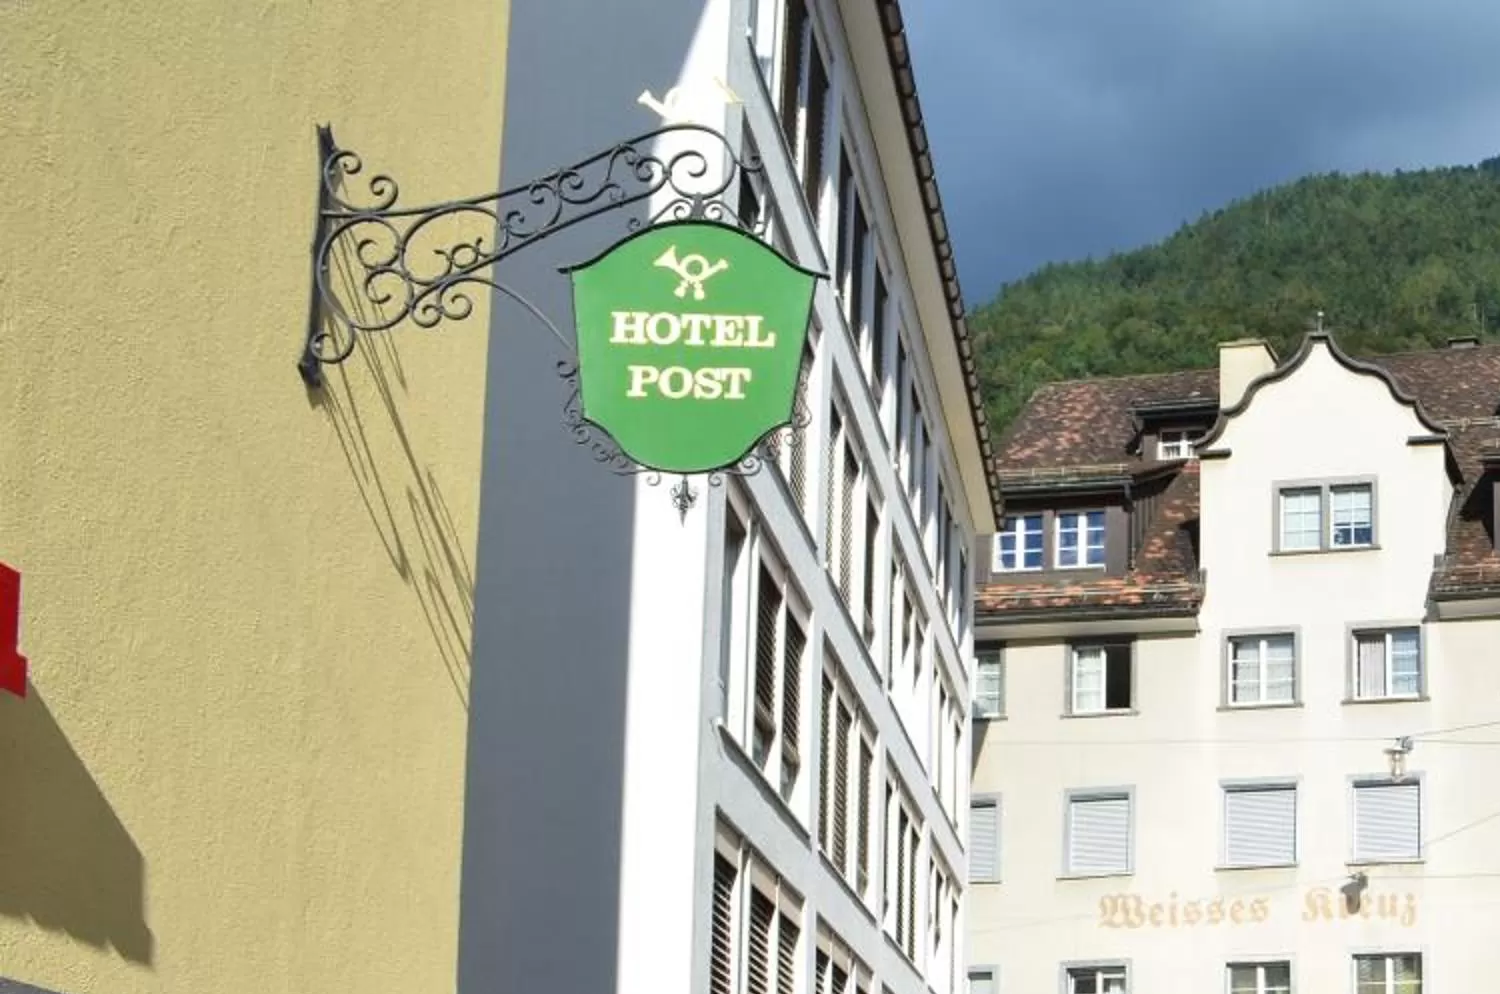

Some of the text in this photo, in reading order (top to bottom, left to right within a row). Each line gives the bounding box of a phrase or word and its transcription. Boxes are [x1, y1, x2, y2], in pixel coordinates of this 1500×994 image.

[609, 311, 776, 348] HOTEL
[626, 365, 752, 400] POST
[1096, 890, 1270, 929] Weisses
